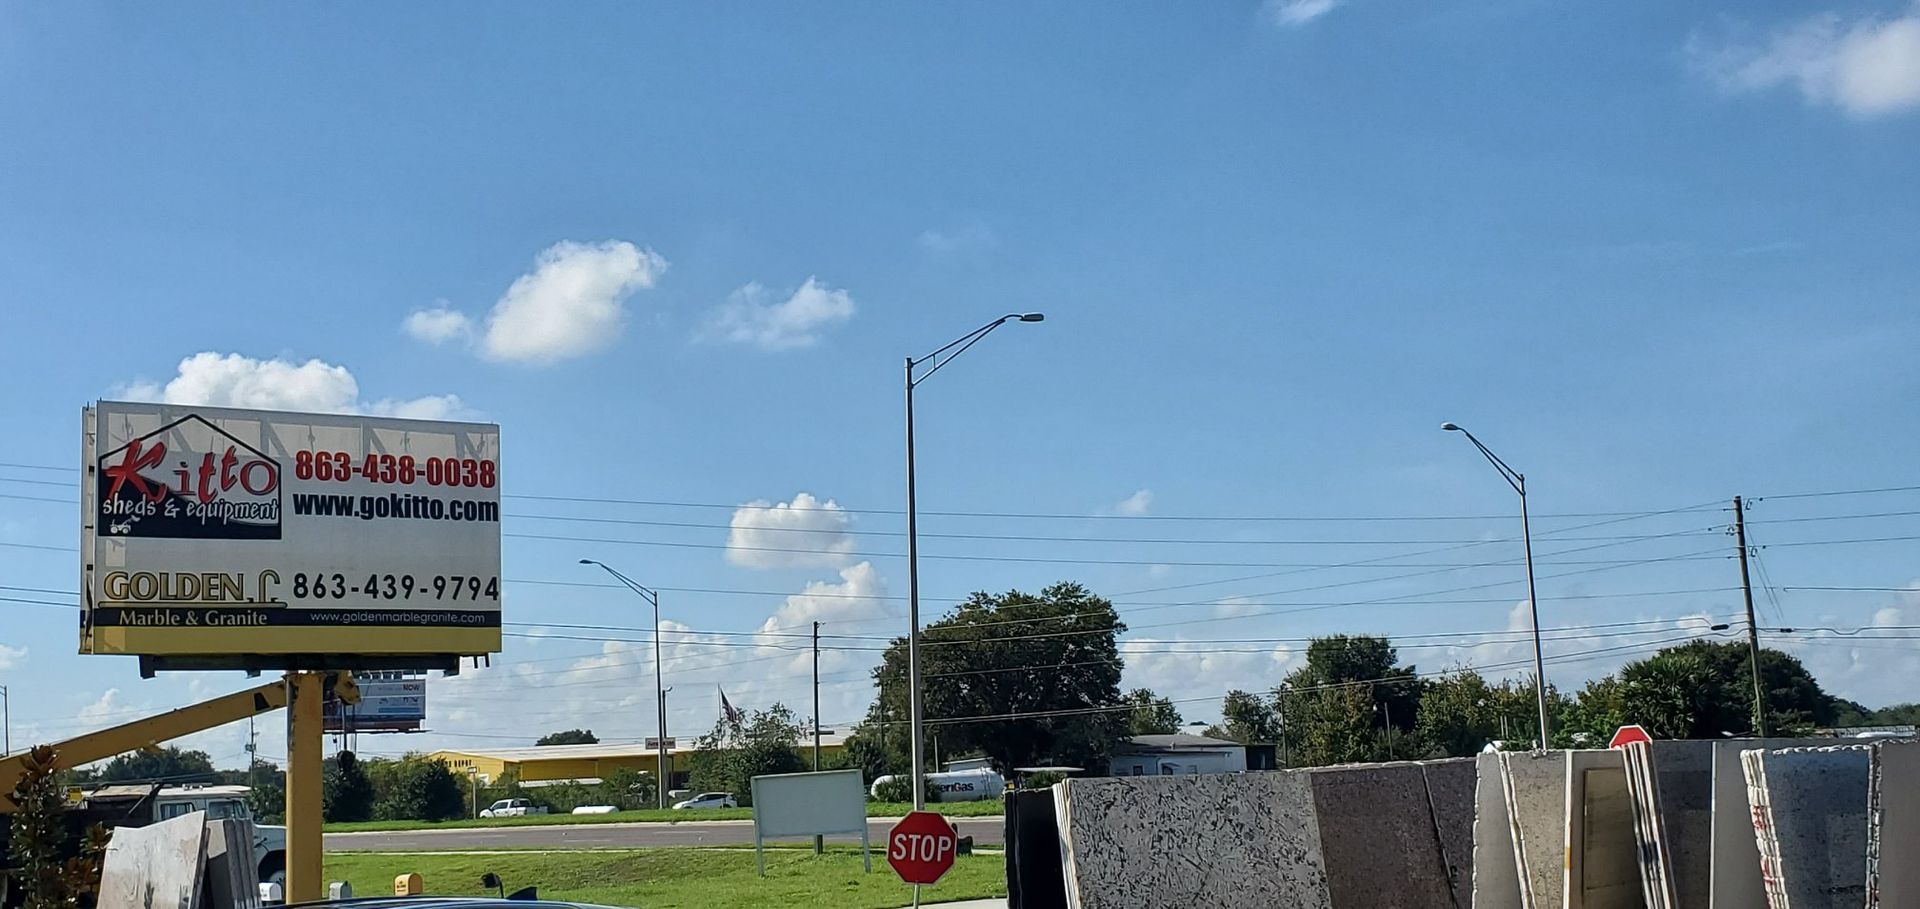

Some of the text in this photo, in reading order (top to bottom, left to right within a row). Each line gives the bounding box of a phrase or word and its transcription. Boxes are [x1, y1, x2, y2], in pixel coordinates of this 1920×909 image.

[102, 438, 278, 504] Kitto
[295, 450, 496, 489] 863-438-0038
[103, 492, 279, 526] sheds & equipment
[292, 493, 499, 522] www.gokitto.com
[103, 571, 244, 601] GOLDEN
[293, 572, 499, 601] 863-439-9794
[119, 609, 268, 626] Marble & Granite
[310, 611, 486, 625] www.goldenmarblegranite.com
[892, 833, 952, 862] STOP
